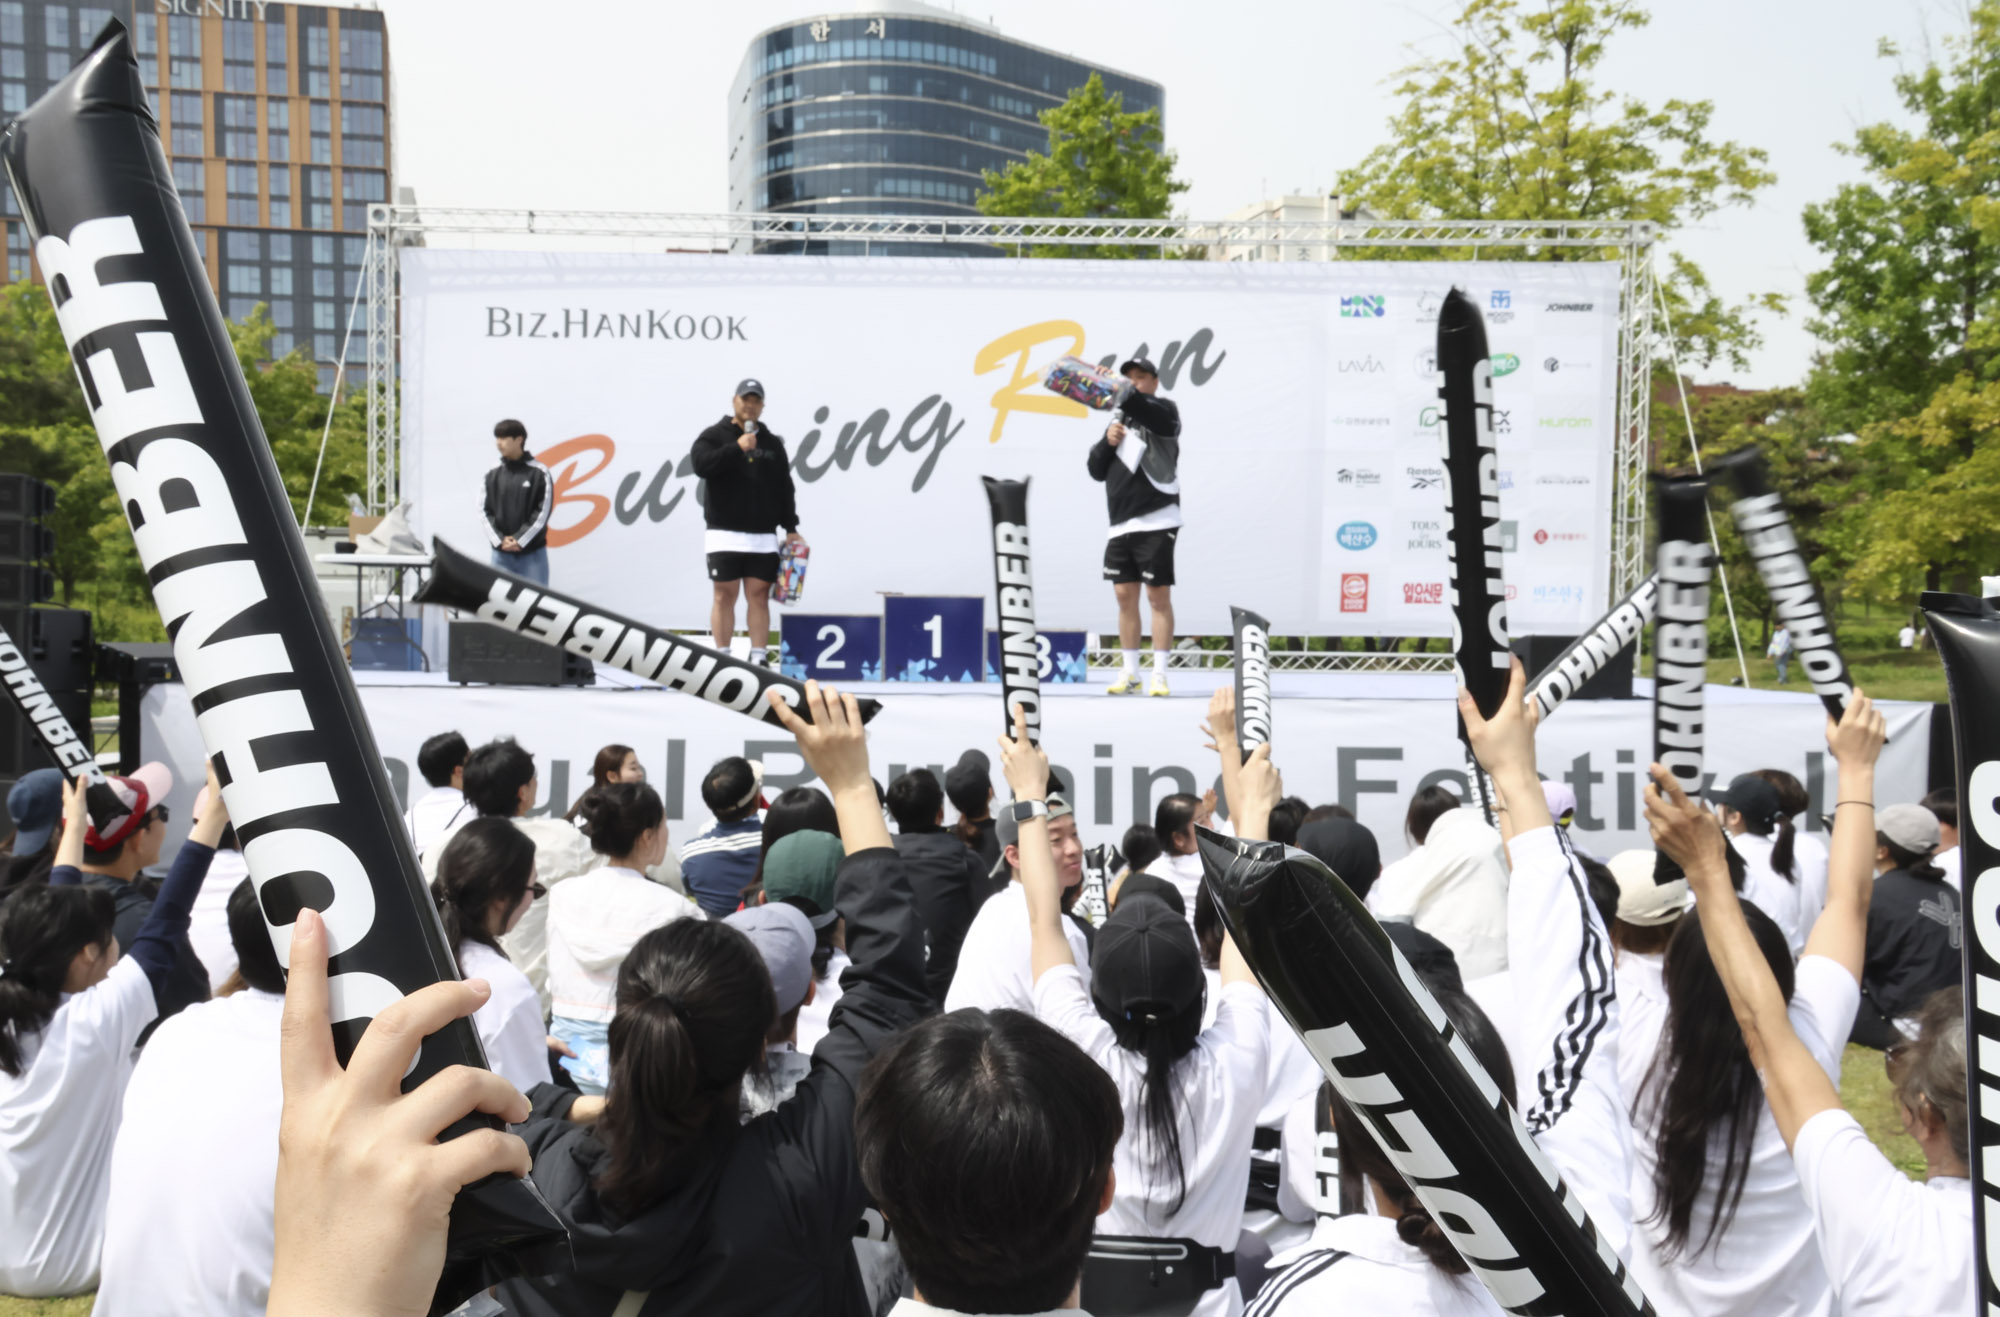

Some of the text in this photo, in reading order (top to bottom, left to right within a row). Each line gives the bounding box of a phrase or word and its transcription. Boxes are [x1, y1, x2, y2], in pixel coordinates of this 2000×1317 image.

[1545, 303, 1594, 312] JOHNBER
[534, 319, 1227, 549] Buing Rn
[1407, 467, 1443, 475] Reebo
[1411, 521, 1440, 531] TOUS
[1408, 540, 1442, 550] JOURS
[1403, 583, 1443, 604] 일요신문
[476, 578, 800, 721] JOHNBER
[816, 624, 846, 669] 2
[923, 615, 943, 658] 1
[1657, 539, 1711, 804] OHNBER
